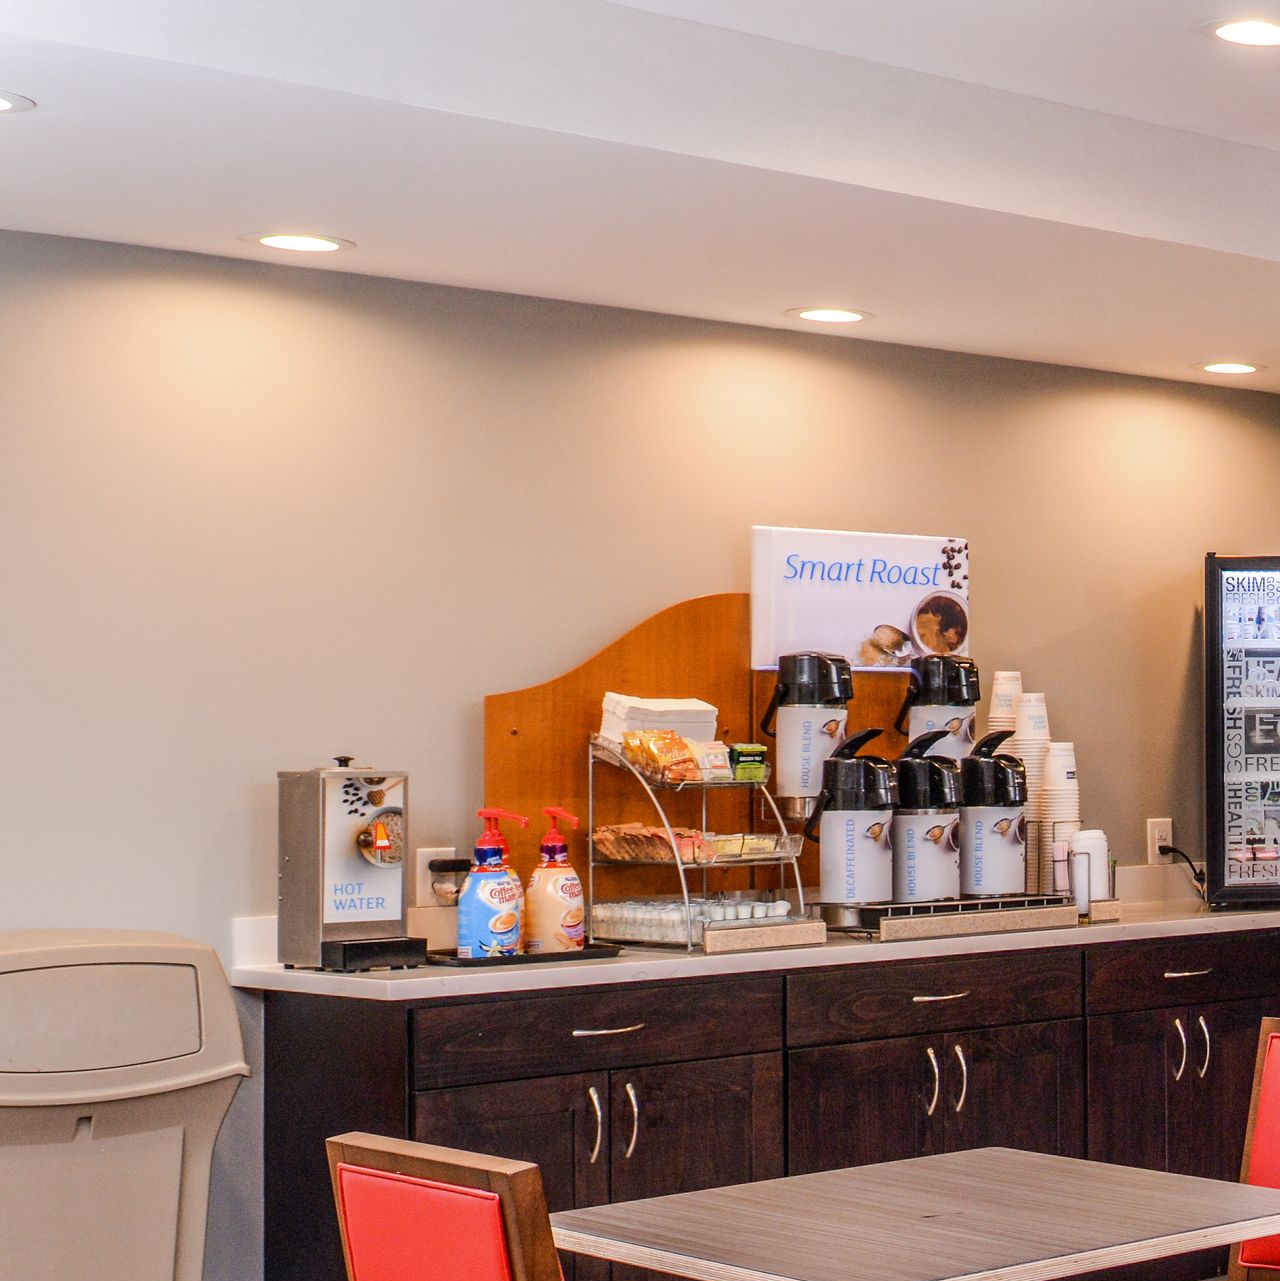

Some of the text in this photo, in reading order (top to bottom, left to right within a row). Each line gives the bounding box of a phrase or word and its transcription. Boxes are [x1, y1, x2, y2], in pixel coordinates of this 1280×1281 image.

[784, 554, 941, 586] Smart Roast
[1225, 577, 1266, 592] SKIM
[1226, 593, 1266, 604] FRESH
[801, 720, 812, 788] HOUSE BLEND
[846, 818, 856, 899] DECAFFEINATED
[907, 828, 916, 896] HOUSE BLEND
[974, 820, 984, 887] HOUSE BLEND
[334, 883, 364, 896] HOT
[490, 886, 514, 899] Coffee
[334, 897, 385, 910] WATER
